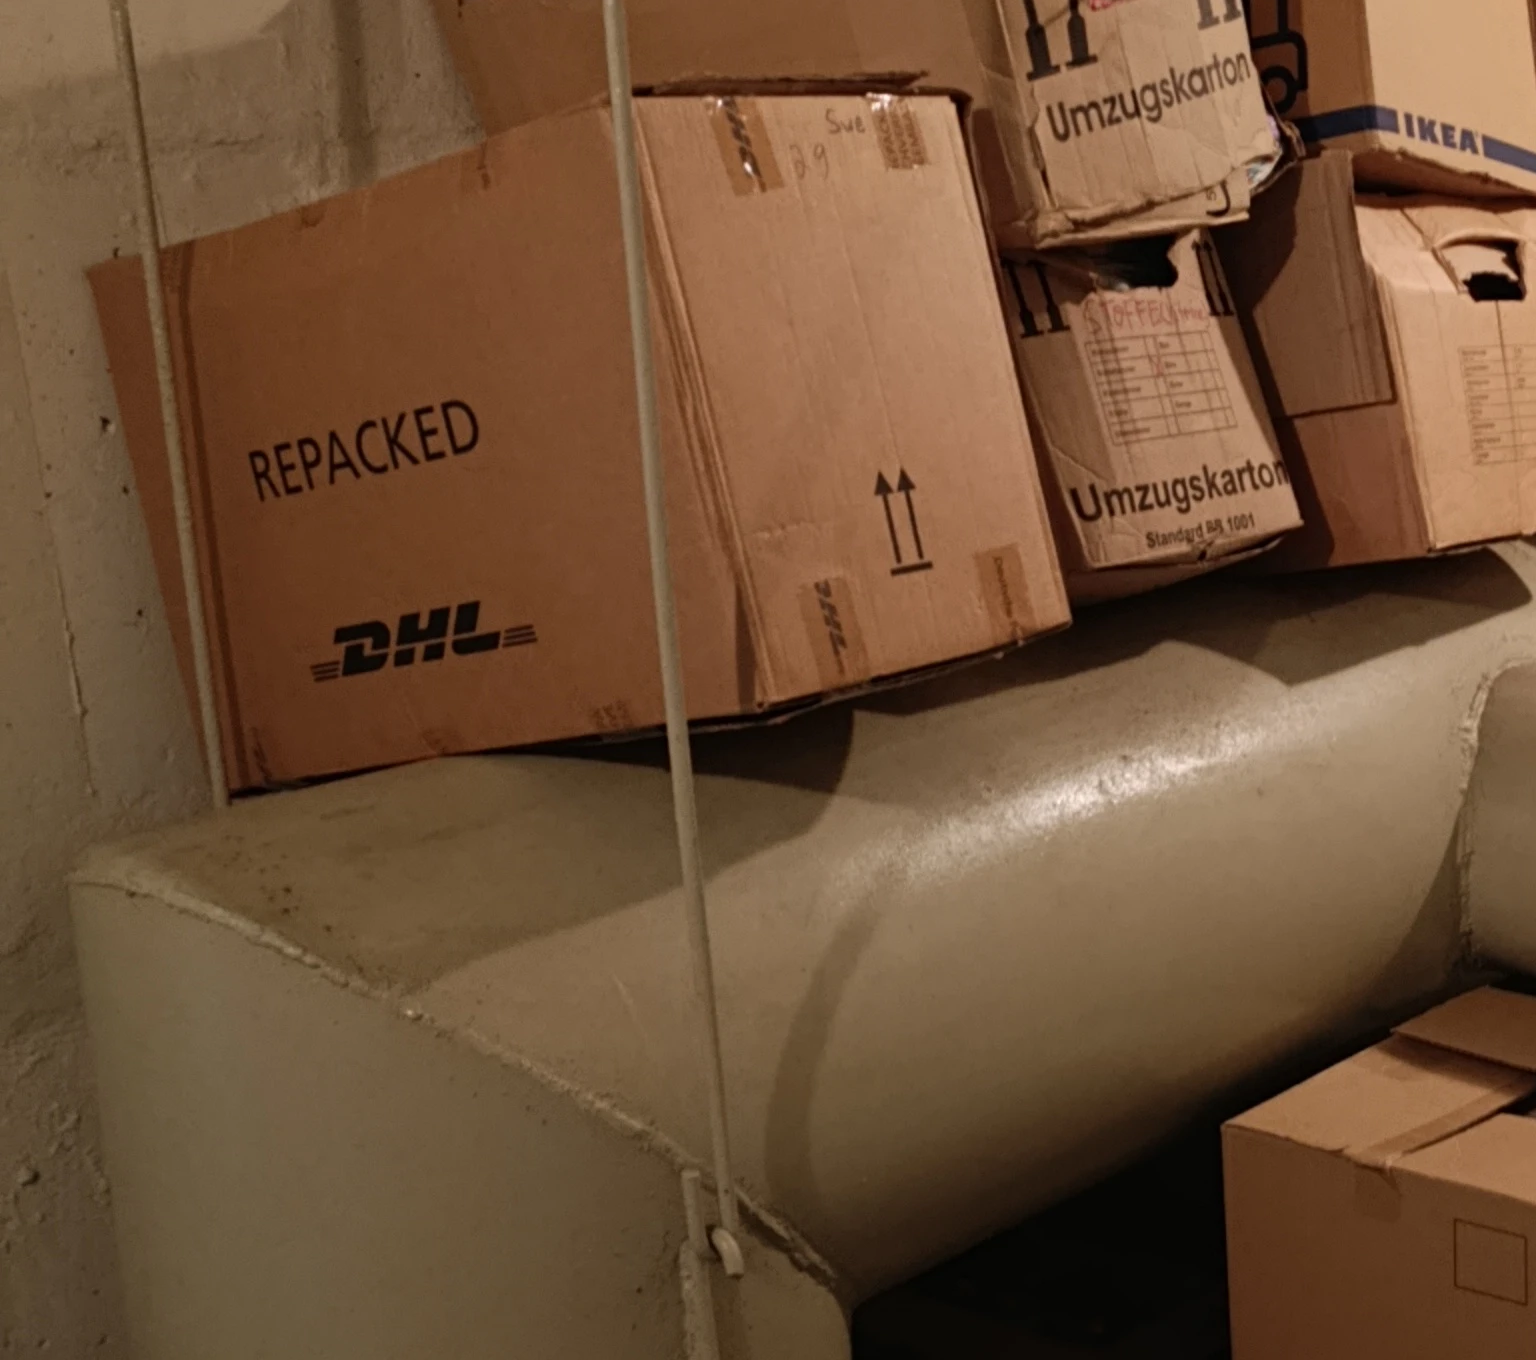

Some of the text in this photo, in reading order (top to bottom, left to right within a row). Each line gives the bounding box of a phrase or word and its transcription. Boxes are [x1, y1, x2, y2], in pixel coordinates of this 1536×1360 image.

[1046, 51, 1251, 143] Umzugskarton
[1404, 112, 1480, 155] IKEA
[248, 399, 480, 502] REPACKED
[1068, 458, 1291, 523] Umzugskarton
[333, 600, 501, 677] DHL
